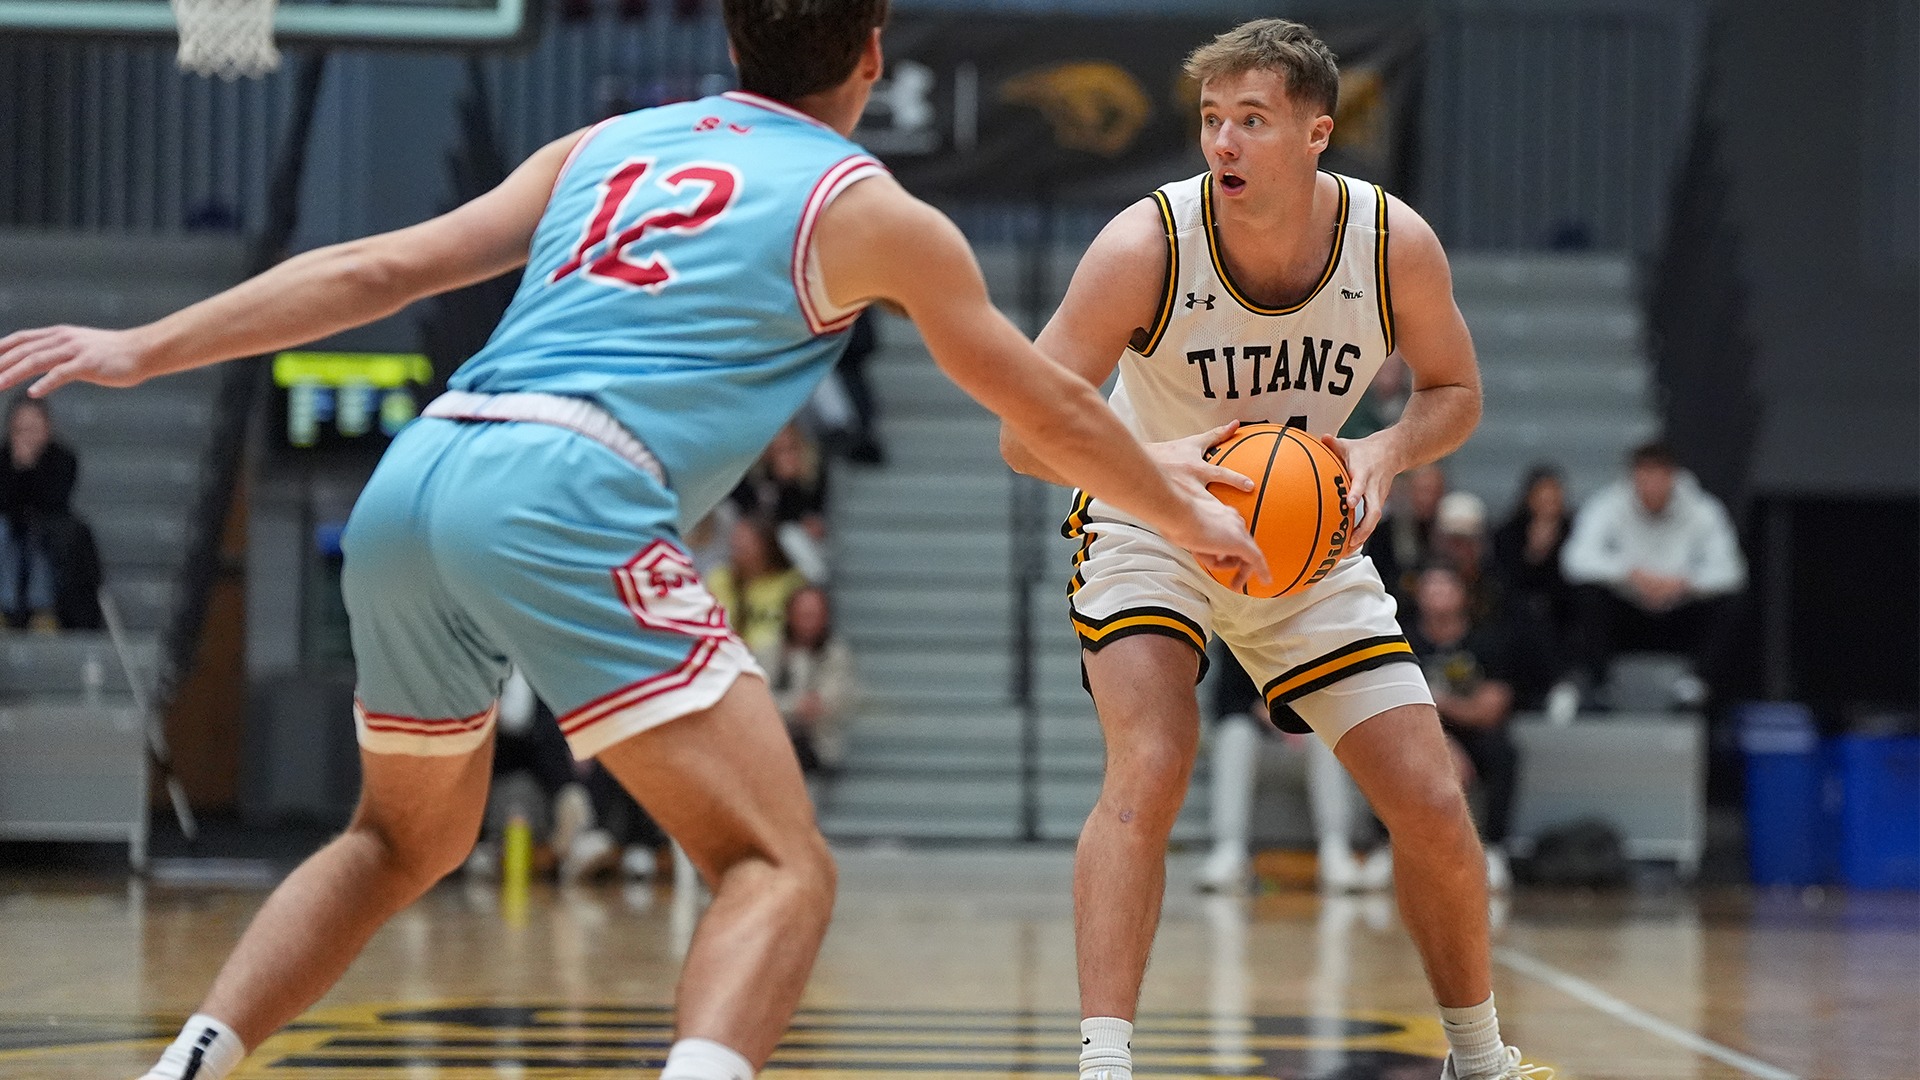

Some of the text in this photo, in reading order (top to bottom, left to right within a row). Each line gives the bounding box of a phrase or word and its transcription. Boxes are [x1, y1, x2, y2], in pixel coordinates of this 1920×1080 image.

[547, 157, 743, 293] 12
[1187, 336, 1361, 399] TITANS
[1303, 474, 1350, 586] Wilson
